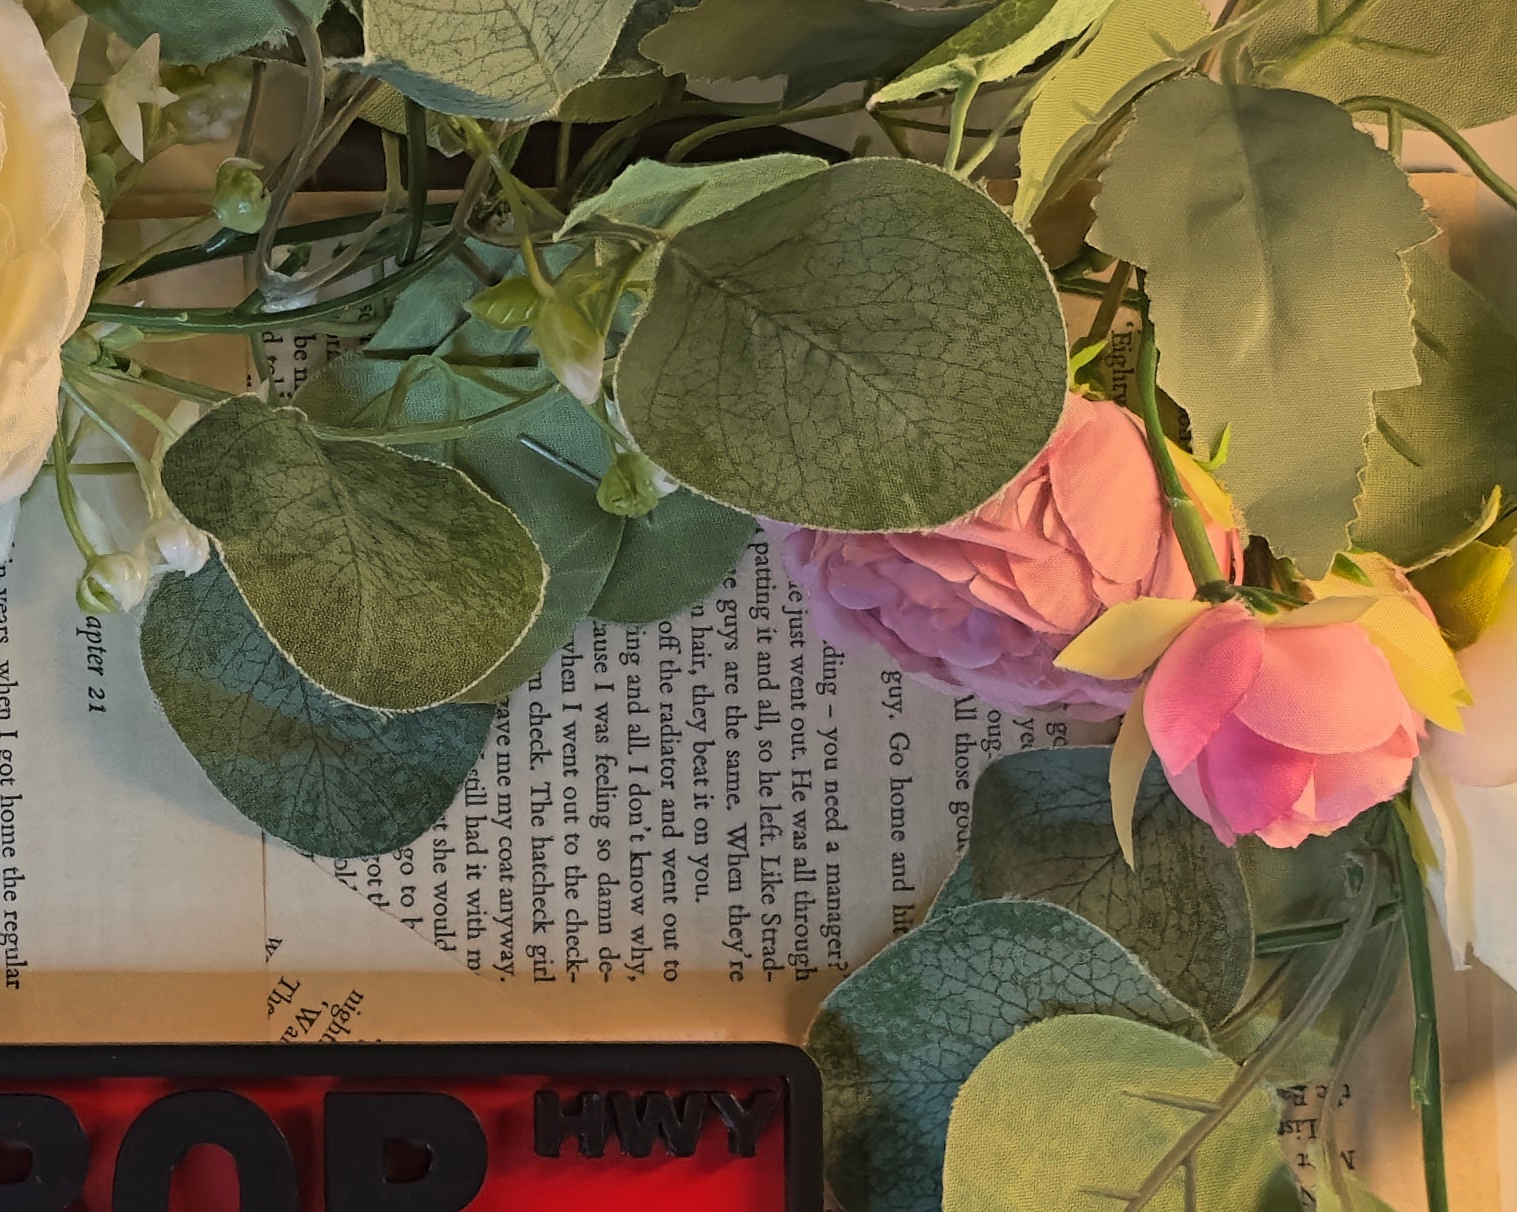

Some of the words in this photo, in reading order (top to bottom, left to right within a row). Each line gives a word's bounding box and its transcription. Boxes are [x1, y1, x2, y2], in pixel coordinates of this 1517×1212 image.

[745, 540, 777, 621] patting
[78, 615, 107, 677] apter
[658, 620, 682, 655] off
[756, 626, 778, 645] it
[658, 659, 683, 694] the
[756, 650, 781, 691] and
[87, 685, 107, 713] 21
[880, 666, 904, 720] guy.
[528, 701, 553, 771] check.
[753, 699, 782, 731] all,
[659, 701, 683, 790] radiator
[757, 739, 773, 763] so
[816, 726, 839, 771] you
[889, 731, 912, 766] Go
[530, 781, 553, 827] The
[757, 769, 782, 798] he
[660, 798, 685, 839] and
[759, 803, 784, 847] left.
[824, 779, 849, 833] need
[889, 775, 913, 842] home
[825, 840, 840, 854] a
[530, 835, 556, 935] hatcheck
[661, 847, 679, 905] went
[760, 854, 784, 905] Like
[891, 851, 916, 893] and
[662, 912, 679, 951] out
[525, 944, 557, 984] girl
[662, 959, 680, 982] to
[531, 1088, 779, 1159] HWY
